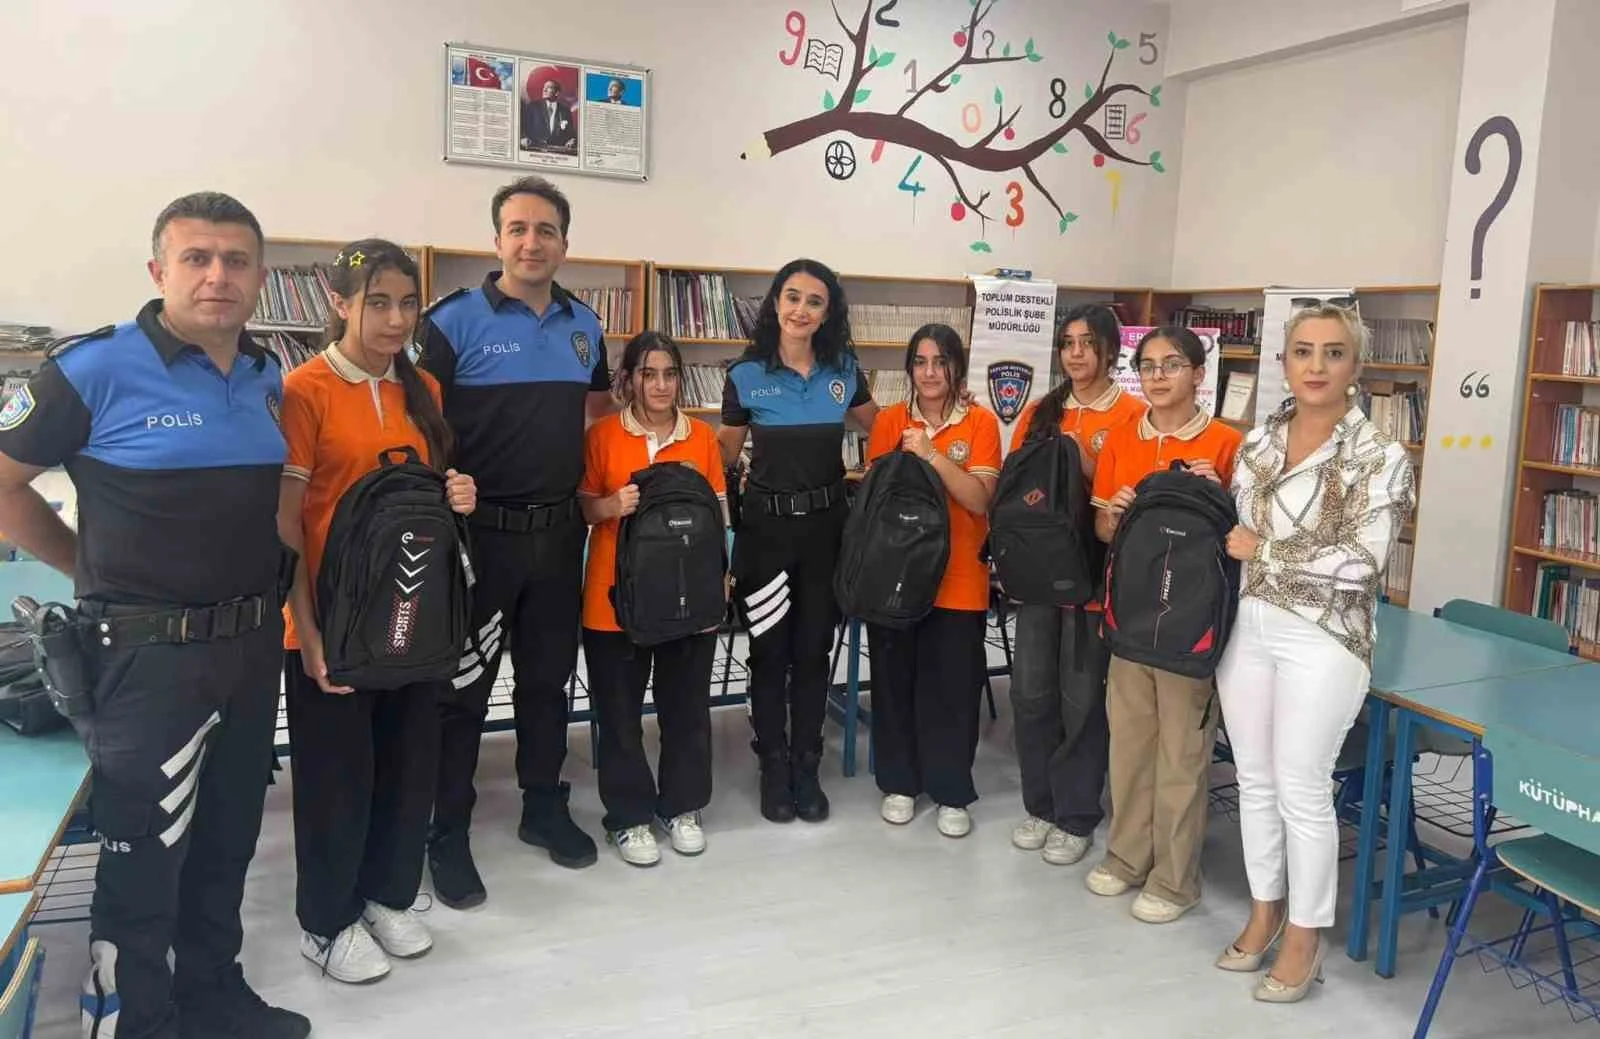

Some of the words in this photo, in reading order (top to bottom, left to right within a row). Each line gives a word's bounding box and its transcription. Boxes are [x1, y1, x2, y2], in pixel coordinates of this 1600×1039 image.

[875, 0, 900, 27] 2
[779, 10, 805, 66] 9
[1139, 31, 1158, 65] 5
[903, 59, 918, 93] 1
[1049, 78, 1067, 118] 8
[962, 102, 981, 134] 0
[1126, 112, 1147, 144] 6
[898, 154, 926, 197] 4
[1006, 181, 1025, 227] 3
[981, 293, 1013, 302] TOPLUM
[1014, 294, 1054, 306] DESTEKLİ
[985, 307, 1022, 318] POLİSLİK
[988, 321, 1041, 333] MÜDÜRLÜĞÜ
[146, 410, 203, 430] POLİS
[393, 601, 412, 648] SPORTS
